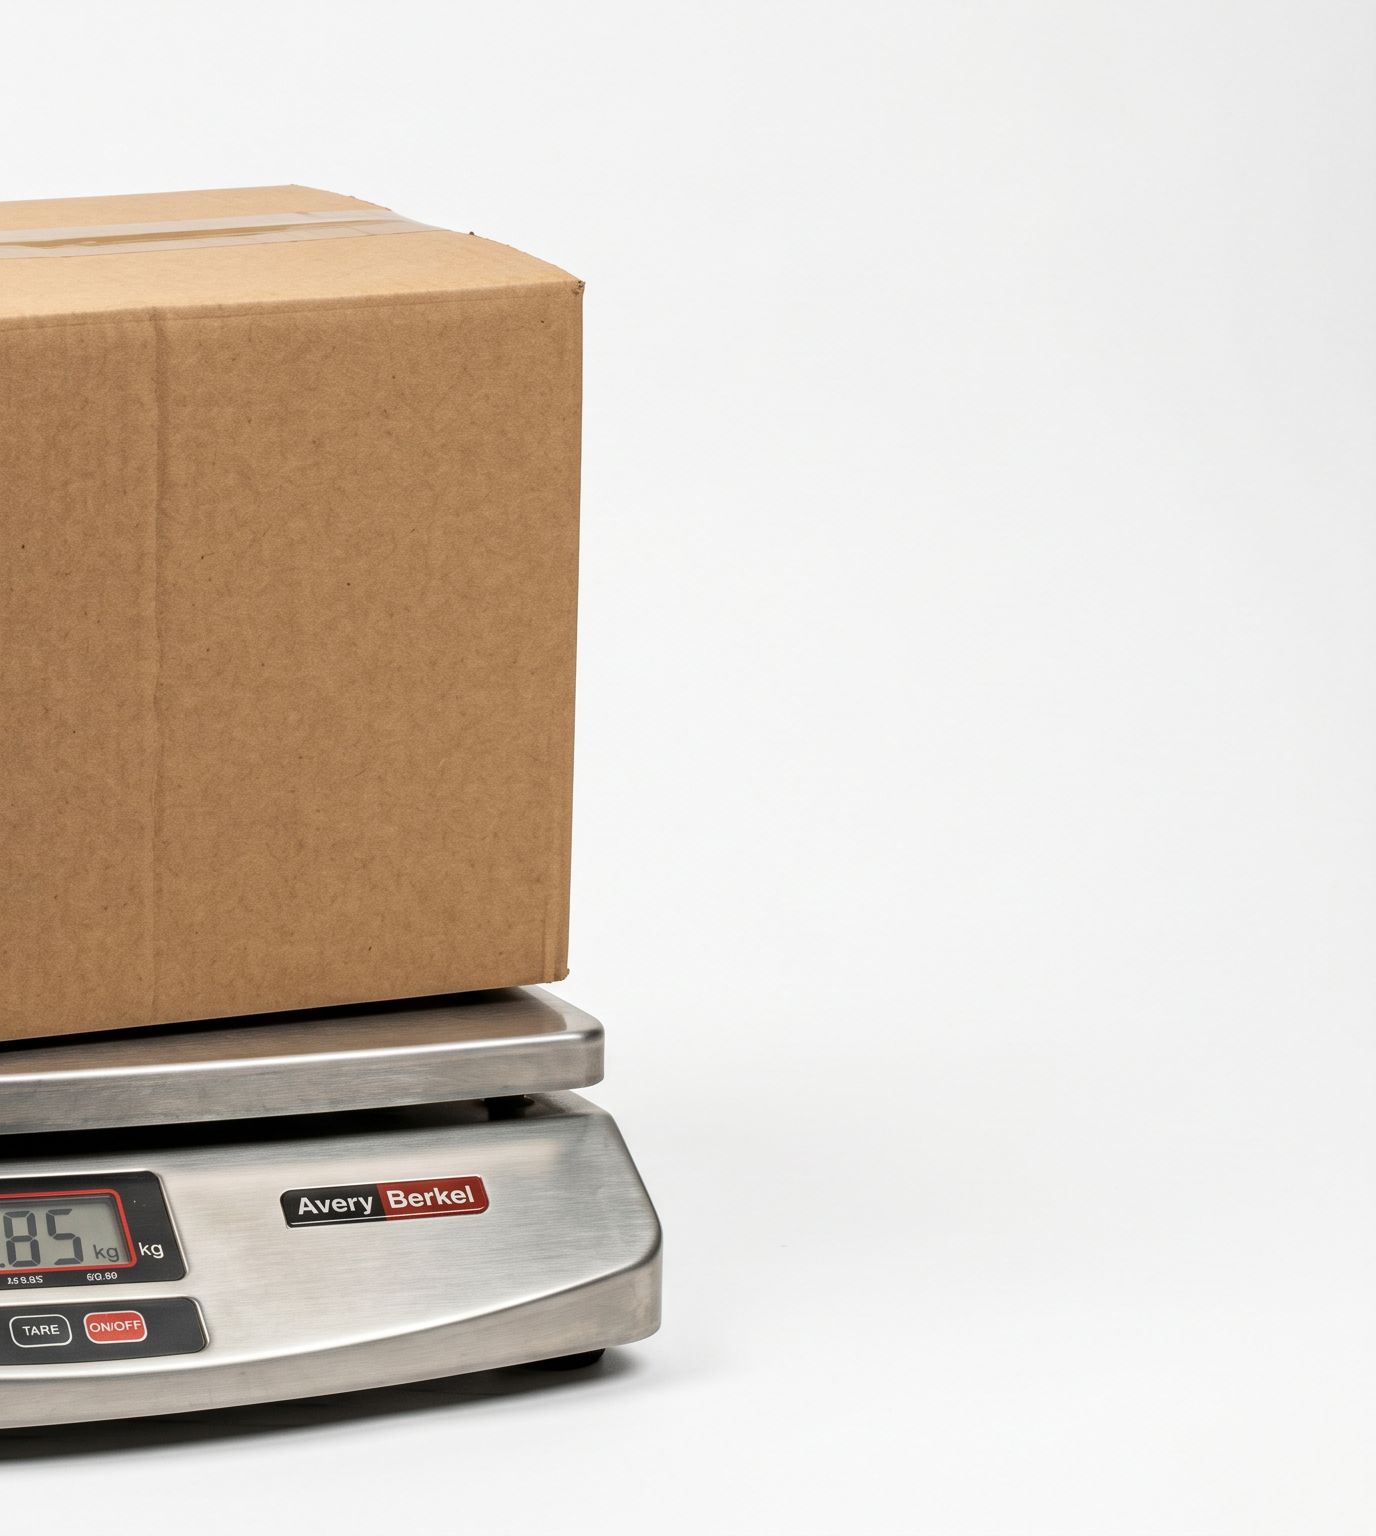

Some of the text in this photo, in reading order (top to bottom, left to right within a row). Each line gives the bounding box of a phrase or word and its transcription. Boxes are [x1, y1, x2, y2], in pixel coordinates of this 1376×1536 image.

[298, 1185, 475, 1215] Avery Berkel
[93, 1244, 120, 1262] kg
[138, 1242, 165, 1259] kg
[22, 1324, 60, 1337] TARE
[89, 1319, 142, 1333] ON/OFF
